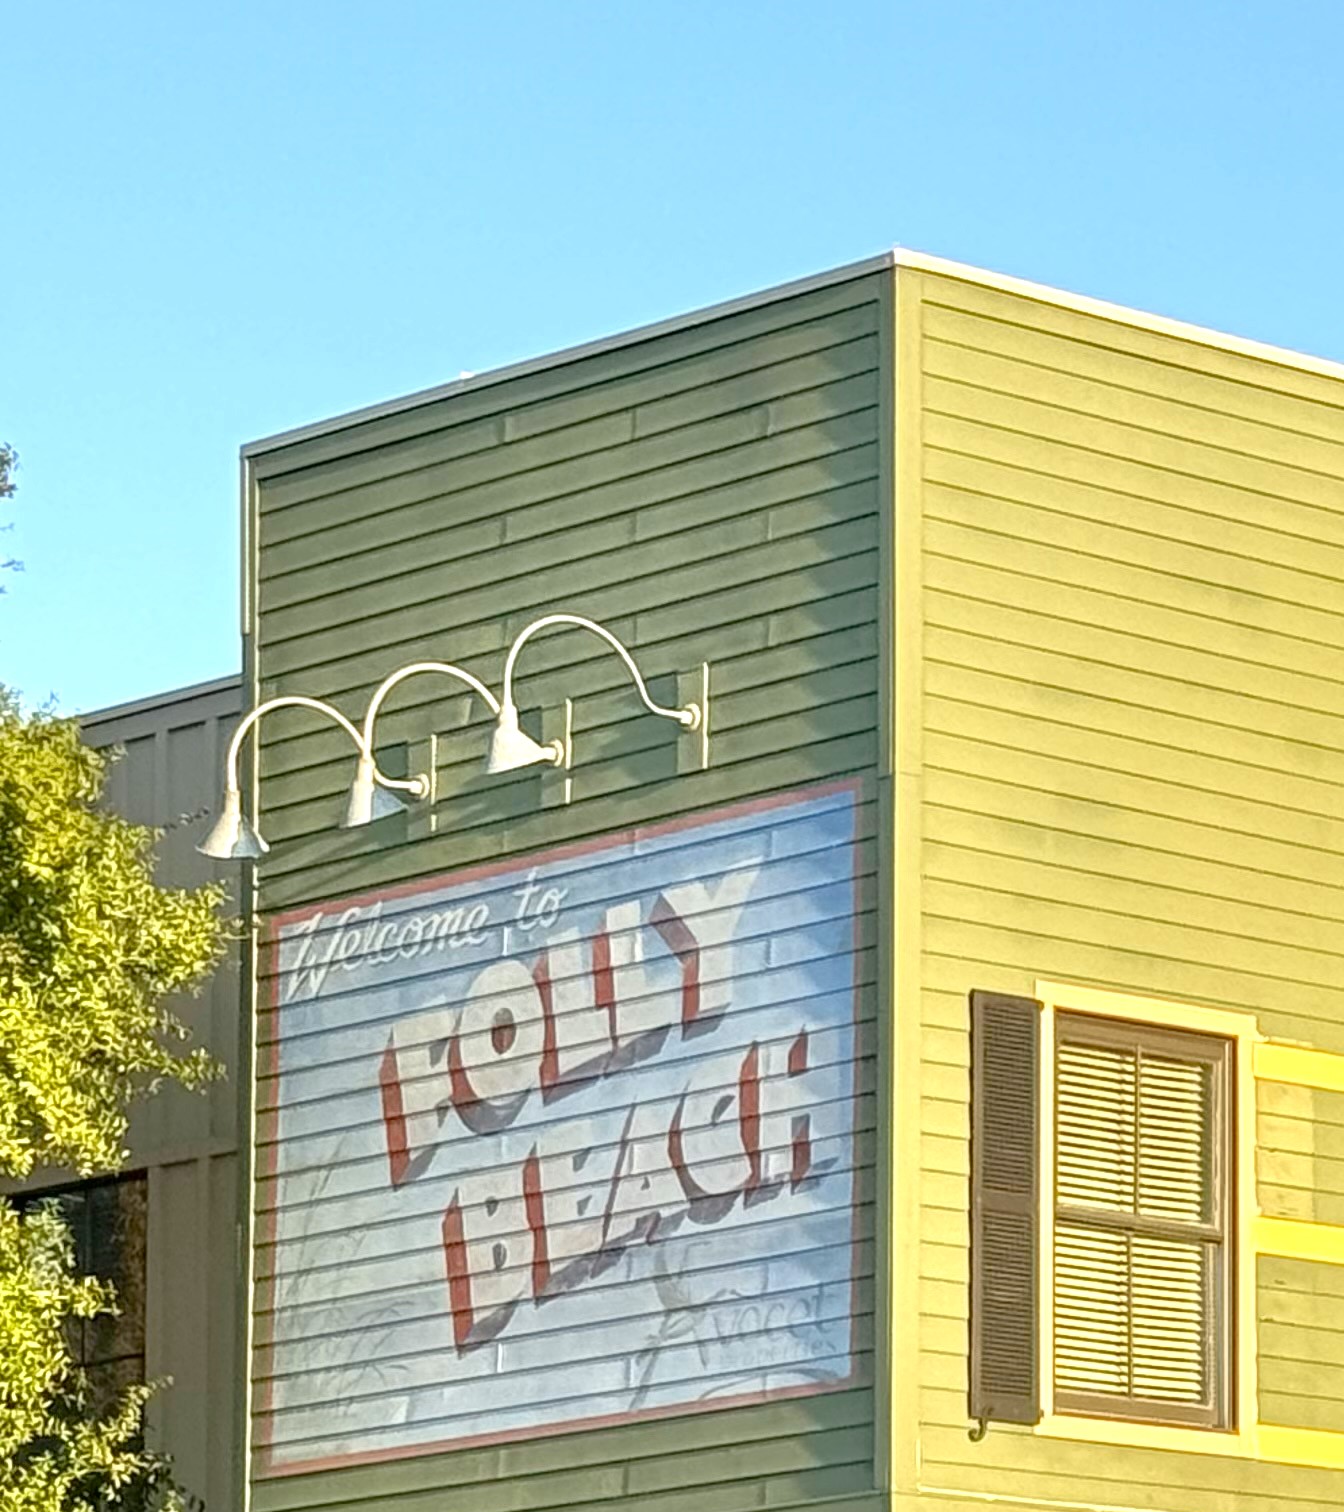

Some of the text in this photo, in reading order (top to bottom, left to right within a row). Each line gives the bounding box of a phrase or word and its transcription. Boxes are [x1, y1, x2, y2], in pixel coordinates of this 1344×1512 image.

[287, 867, 569, 1001] Welcome to
[379, 857, 763, 1191] FOLLY
[442, 1025, 838, 1358] BEACH
